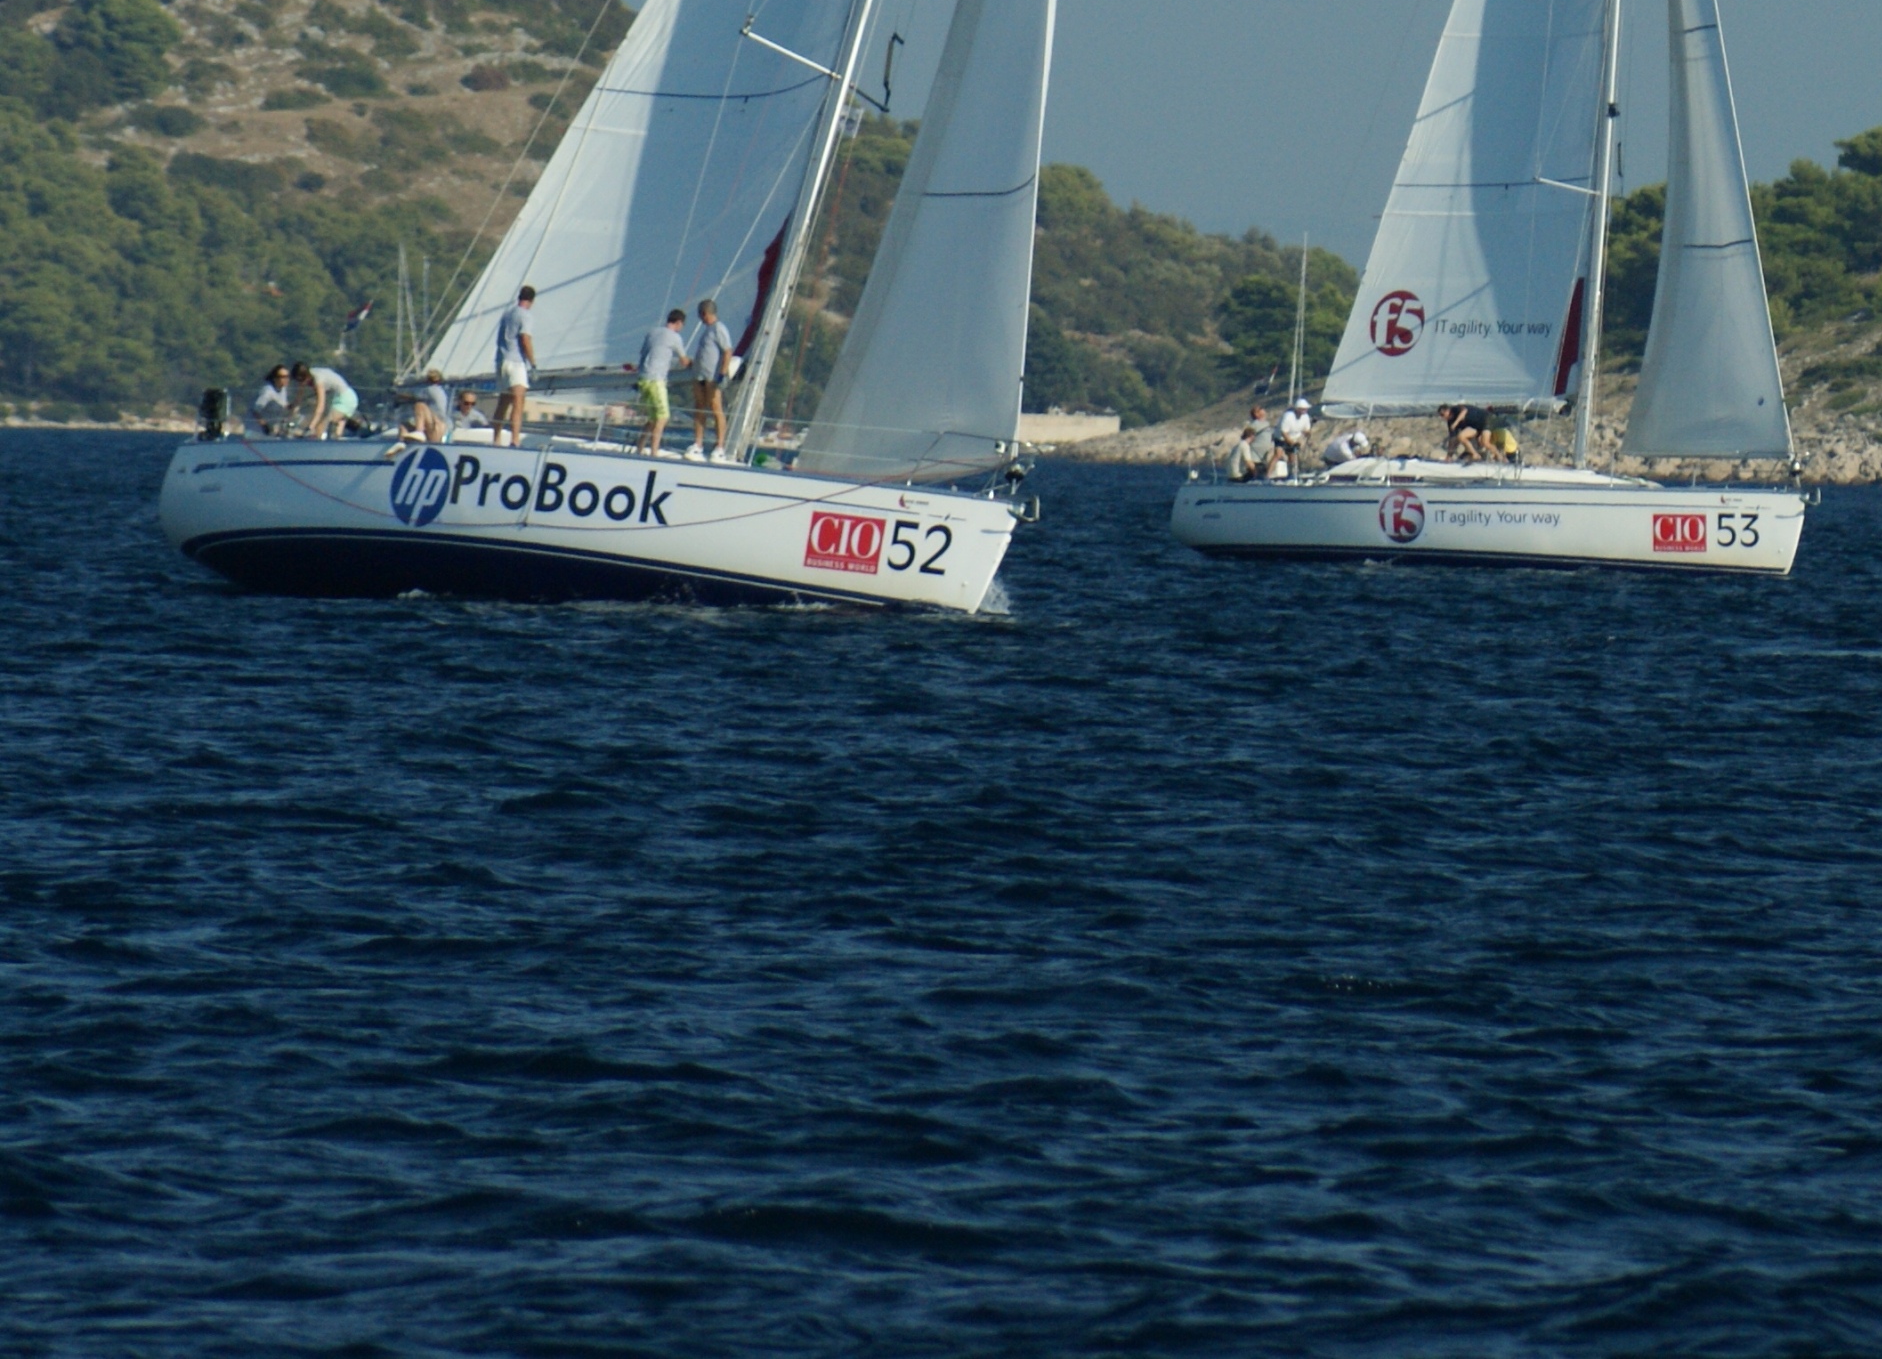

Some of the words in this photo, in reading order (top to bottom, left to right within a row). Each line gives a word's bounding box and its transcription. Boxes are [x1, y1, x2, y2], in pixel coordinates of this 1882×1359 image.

[1373, 297, 1424, 349] f5
[1434, 319, 1449, 333] IT
[1497, 320, 1525, 335] Your
[394, 447, 448, 527] hp
[450, 454, 673, 526] ProBook
[1382, 495, 1425, 537] f5
[1434, 510, 1447, 524] IT
[1497, 510, 1528, 525] Your
[1654, 515, 1705, 542] CIO
[1717, 513, 1759, 548] 53
[810, 515, 881, 559] CIO
[887, 519, 953, 575] 52
[806, 557, 845, 570] BUSINESS
[847, 561, 877, 573] WORLD
